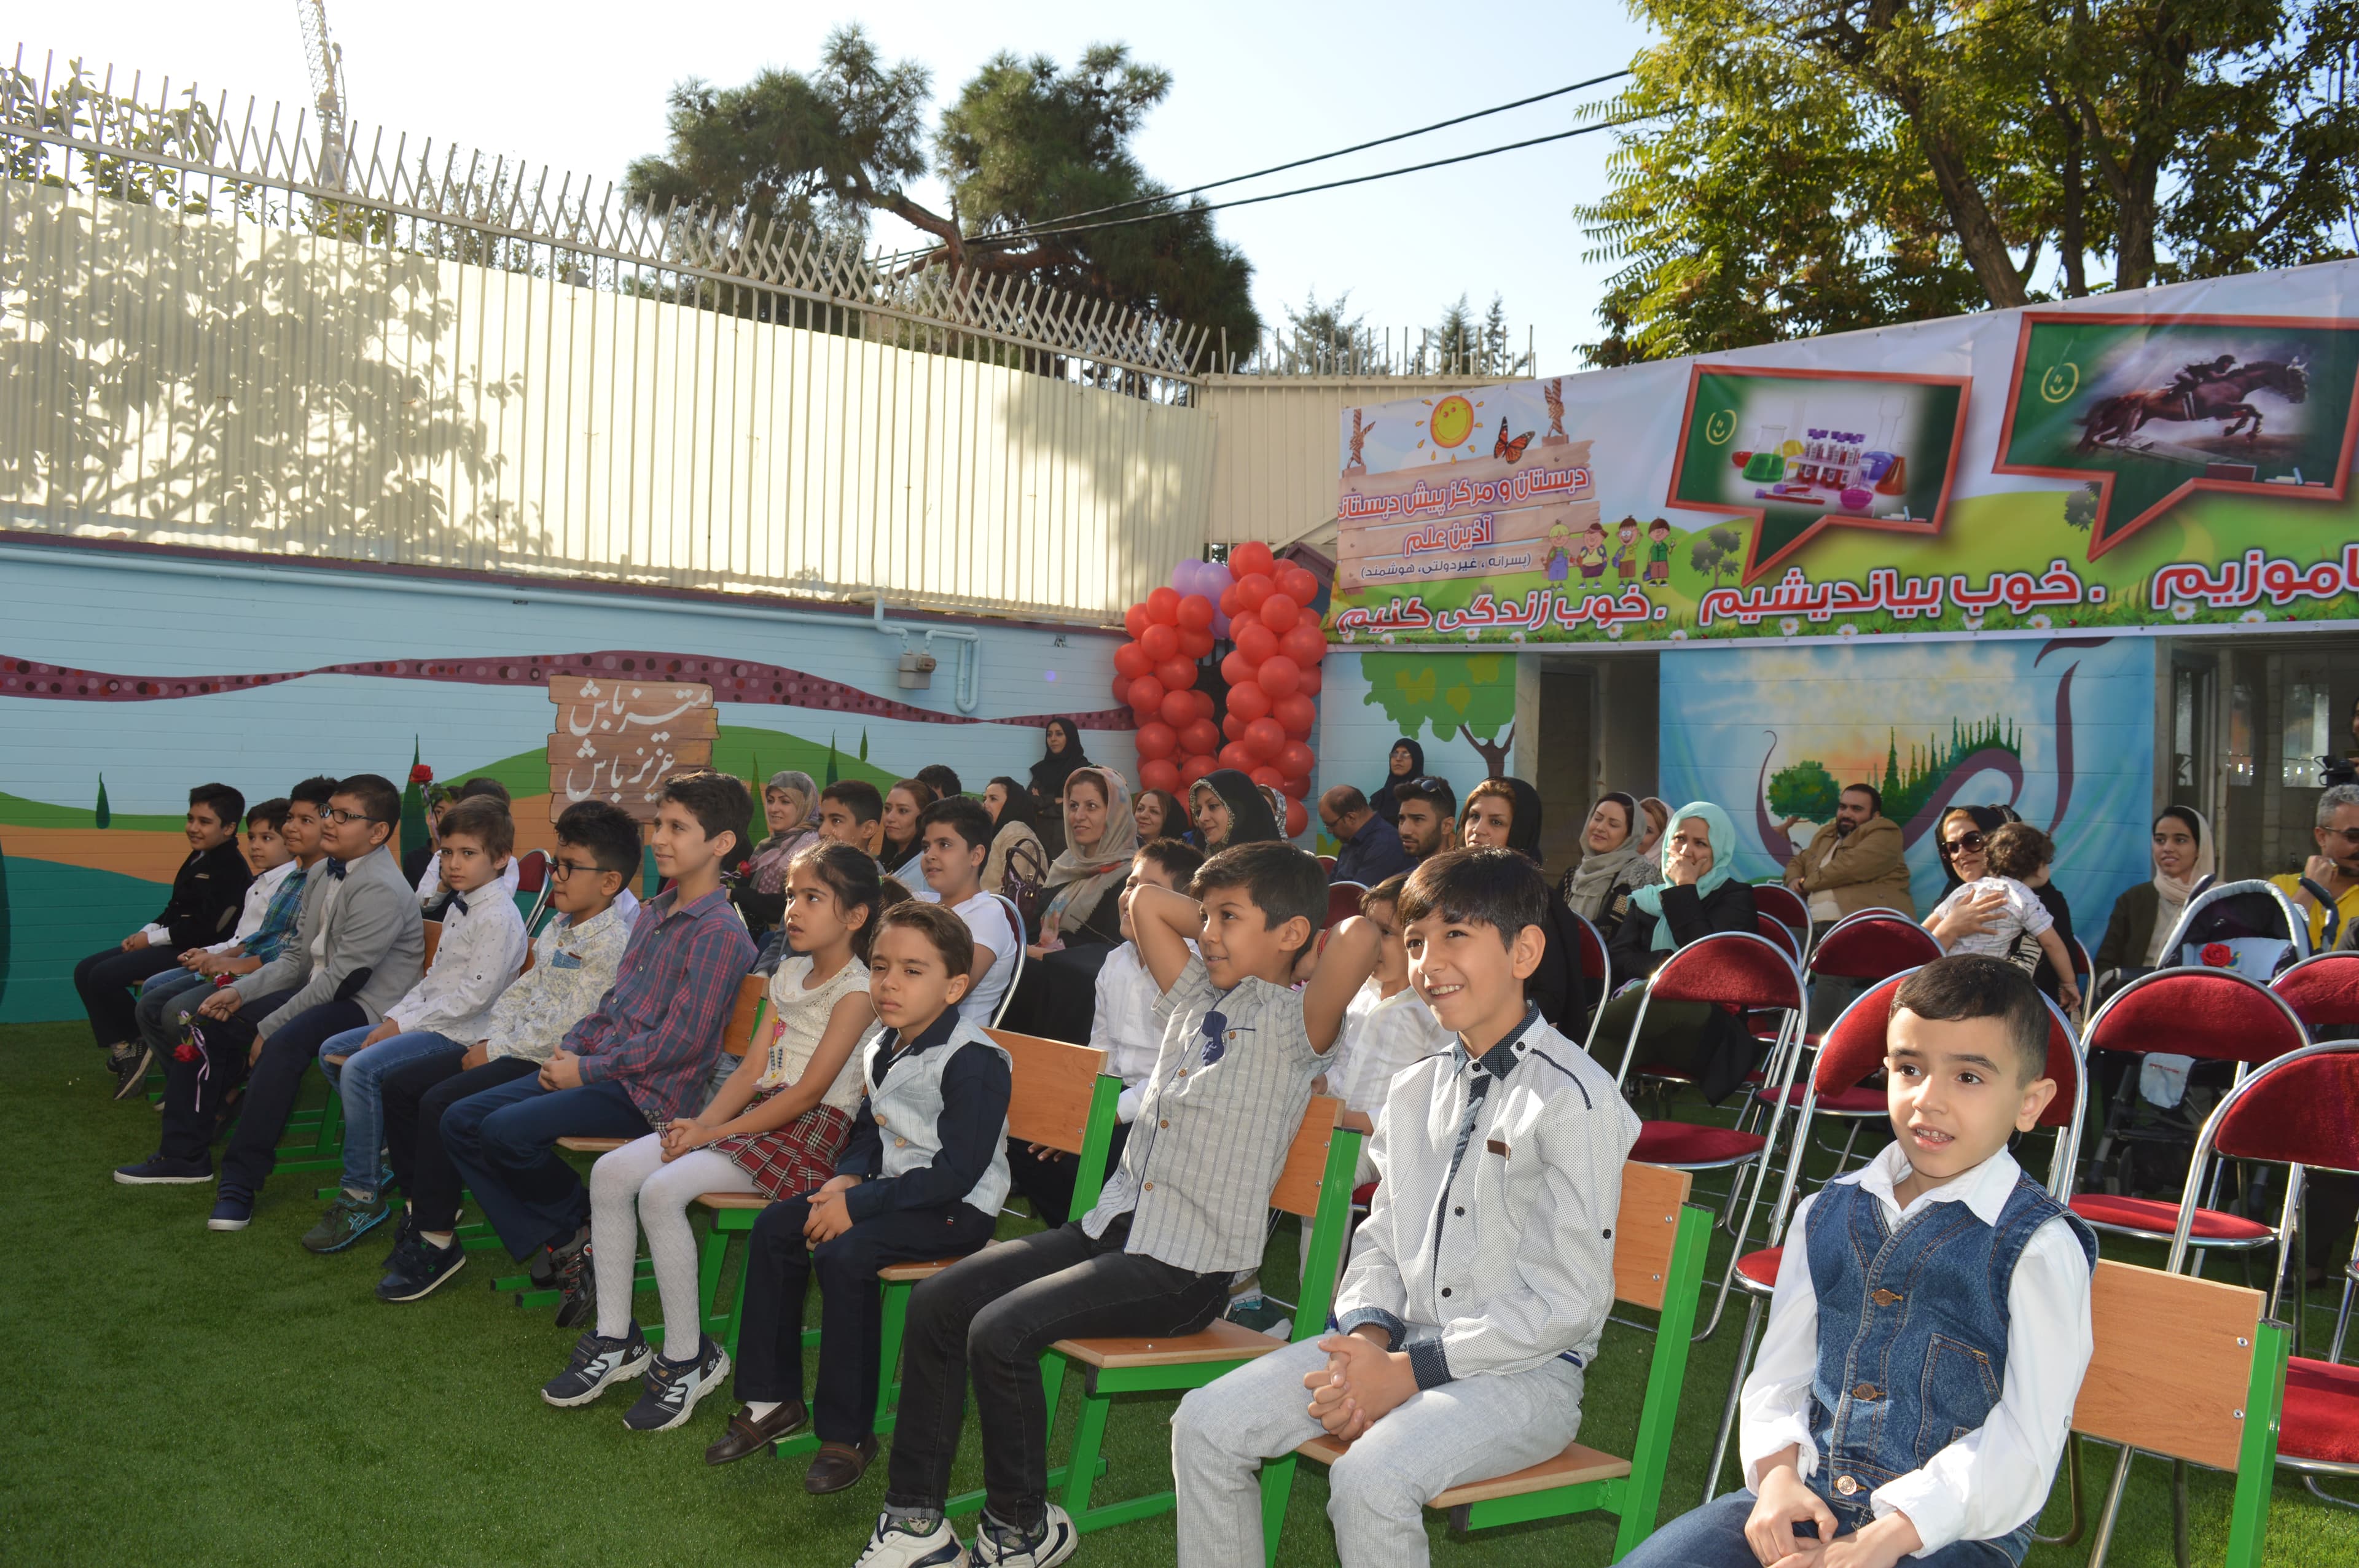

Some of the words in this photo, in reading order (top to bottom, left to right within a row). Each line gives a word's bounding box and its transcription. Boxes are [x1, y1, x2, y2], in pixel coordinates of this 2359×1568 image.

[1402, 481, 1446, 516] پیش
[1447, 479, 1495, 510] مرکز
[1498, 480, 1512, 503] و
[1514, 467, 1589, 501] دبستان
[1338, 495, 1401, 519] دبستان
[1404, 526, 1446, 557] علم
[1448, 515, 1492, 551] آذین
[2152, 544, 2359, 609] اموزیم
[1436, 590, 1551, 631] زندگی
[1699, 568, 1944, 626] بیاندیشیم
[1337, 598, 1432, 634] کنیم
[569, 679, 625, 736] باش
[566, 738, 624, 803] باش
[663, 1386, 686, 1403] N
